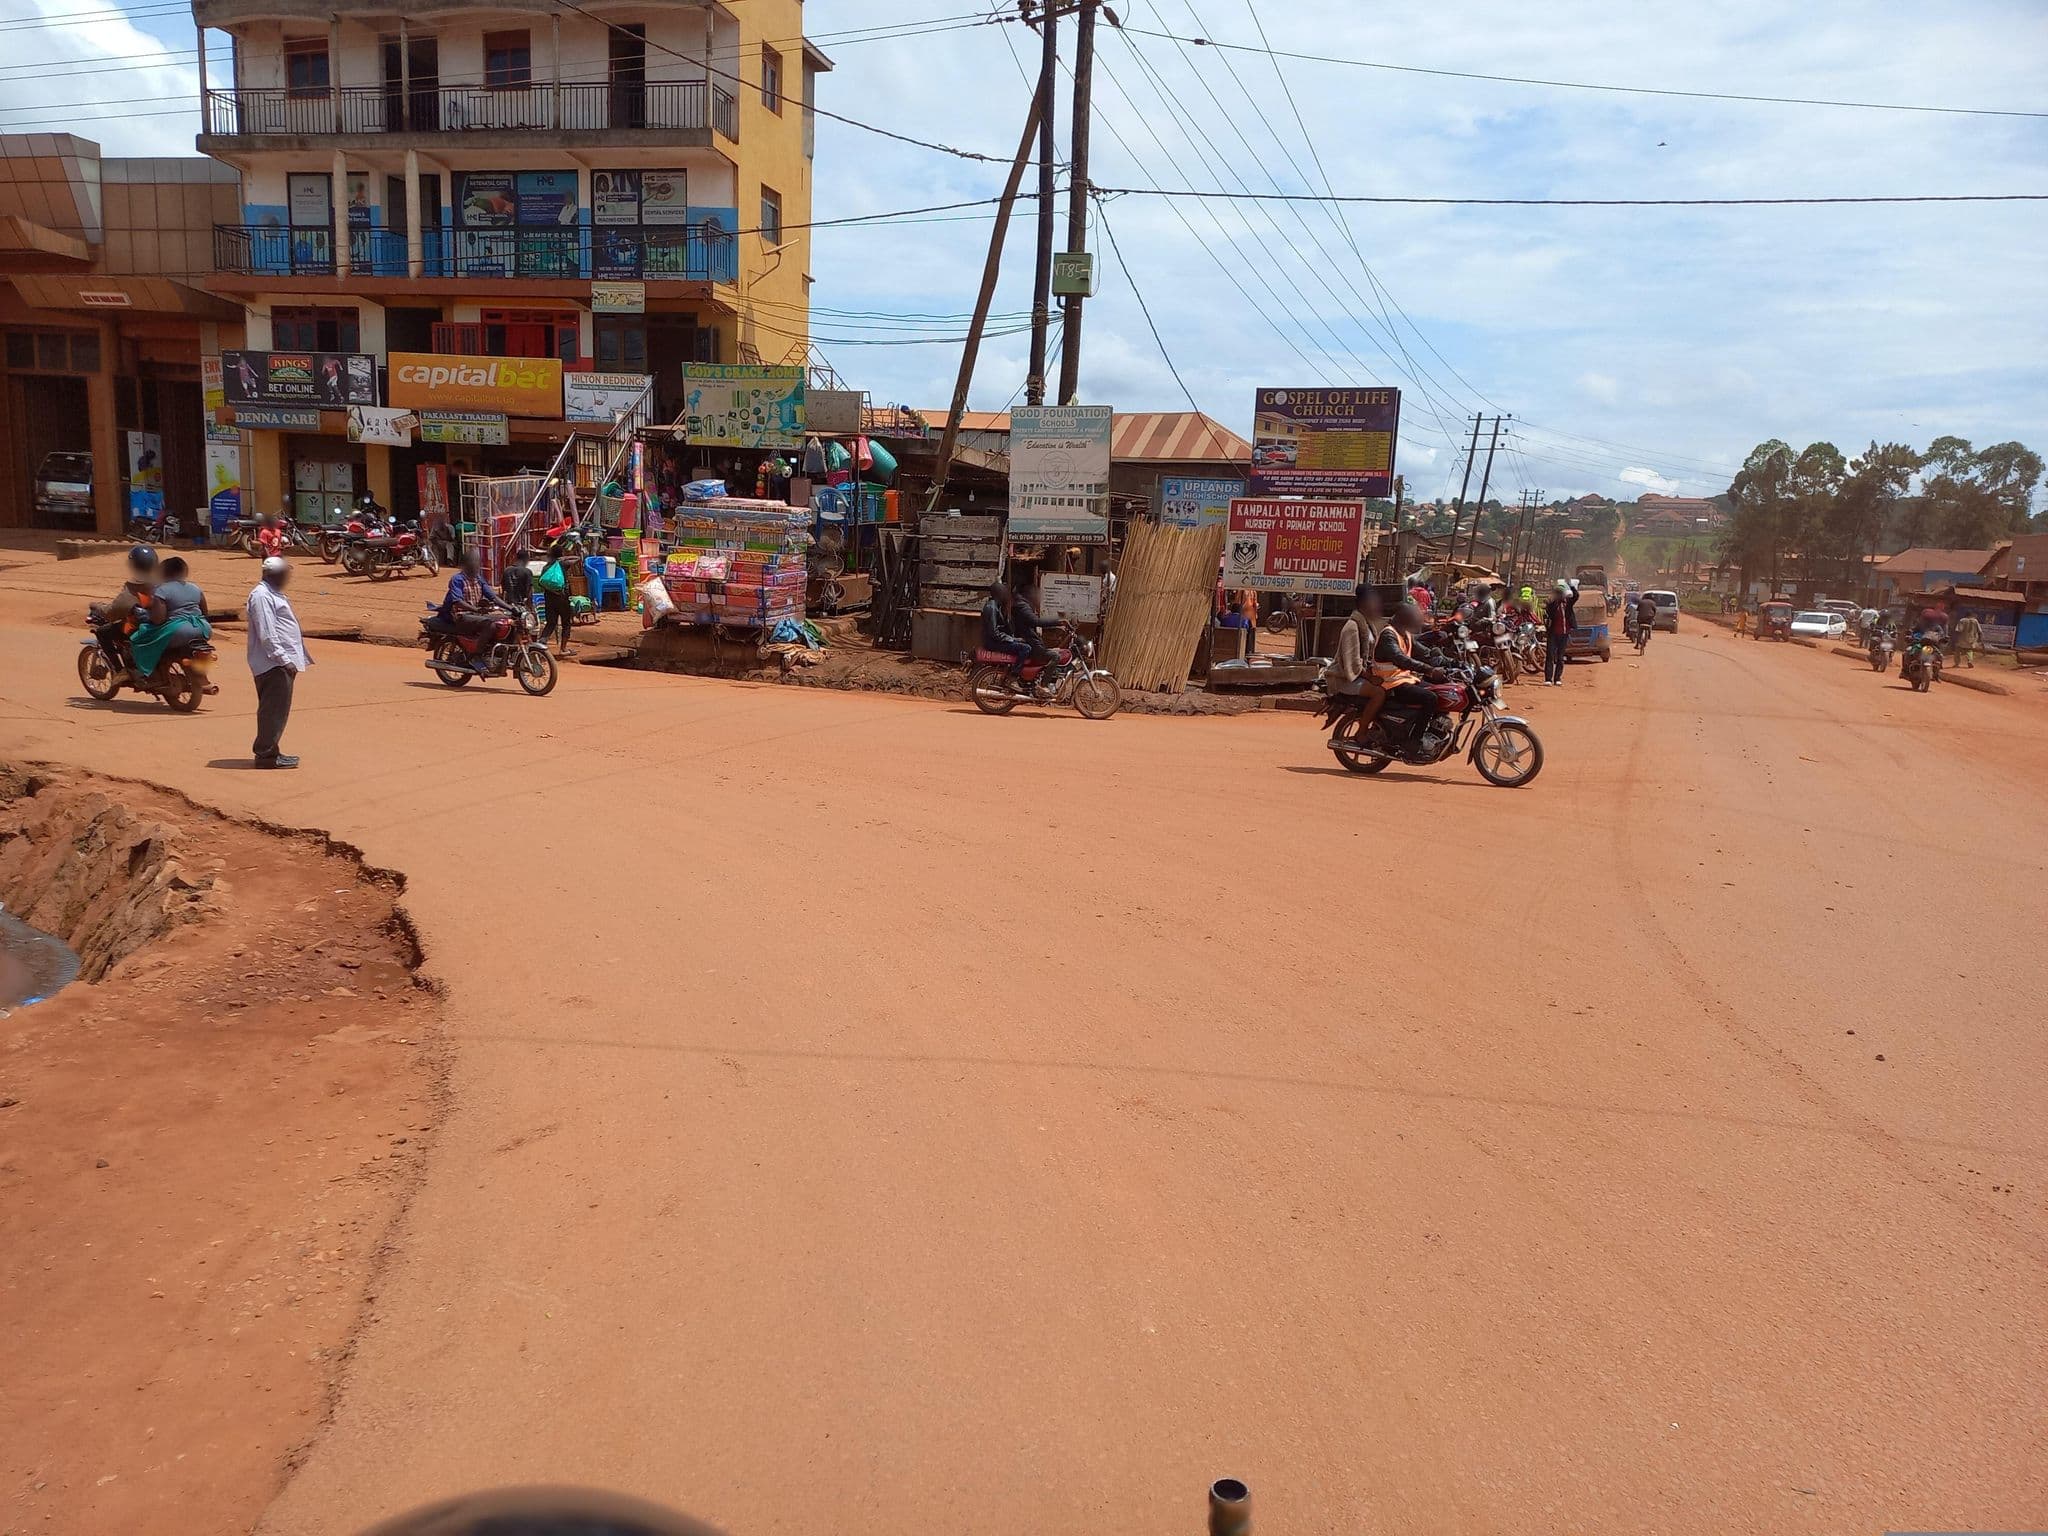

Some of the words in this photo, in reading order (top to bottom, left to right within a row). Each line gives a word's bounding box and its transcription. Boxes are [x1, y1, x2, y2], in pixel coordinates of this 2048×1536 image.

[687, 367, 723, 378] GOD'S
[767, 367, 801, 378] HOME
[571, 375, 602, 384] HILTON
[603, 376, 646, 386] BEDDINGS
[269, 383, 285, 393] BET
[286, 384, 315, 394] ONLINE
[1263, 390, 1324, 405] GOSPEL
[1328, 391, 1351, 405] OF
[1355, 391, 1389, 405] LIFE
[1012, 408, 1040, 418] GOOD
[1043, 408, 1108, 418] FOUNDATION
[1293, 405, 1355, 416] CHURCH
[235, 411, 280, 424] DENNA
[282, 413, 317, 425] CARE
[465, 413, 502, 422] TRADERS
[1184, 482, 1241, 493] UPLANDS
[1236, 504, 1281, 517] KAMPALA
[1284, 506, 1308, 518] CITY
[1309, 506, 1356, 519] GRAMMAR
[1244, 519, 1276, 529] NURSERY
[1286, 520, 1317, 532] PRIMARY
[1318, 521, 1347, 532] SCHOOL
[1276, 535, 1293, 551] Day
[1300, 536, 1344, 554] Boarding
[1273, 558, 1348, 573] MUTUNDWE
